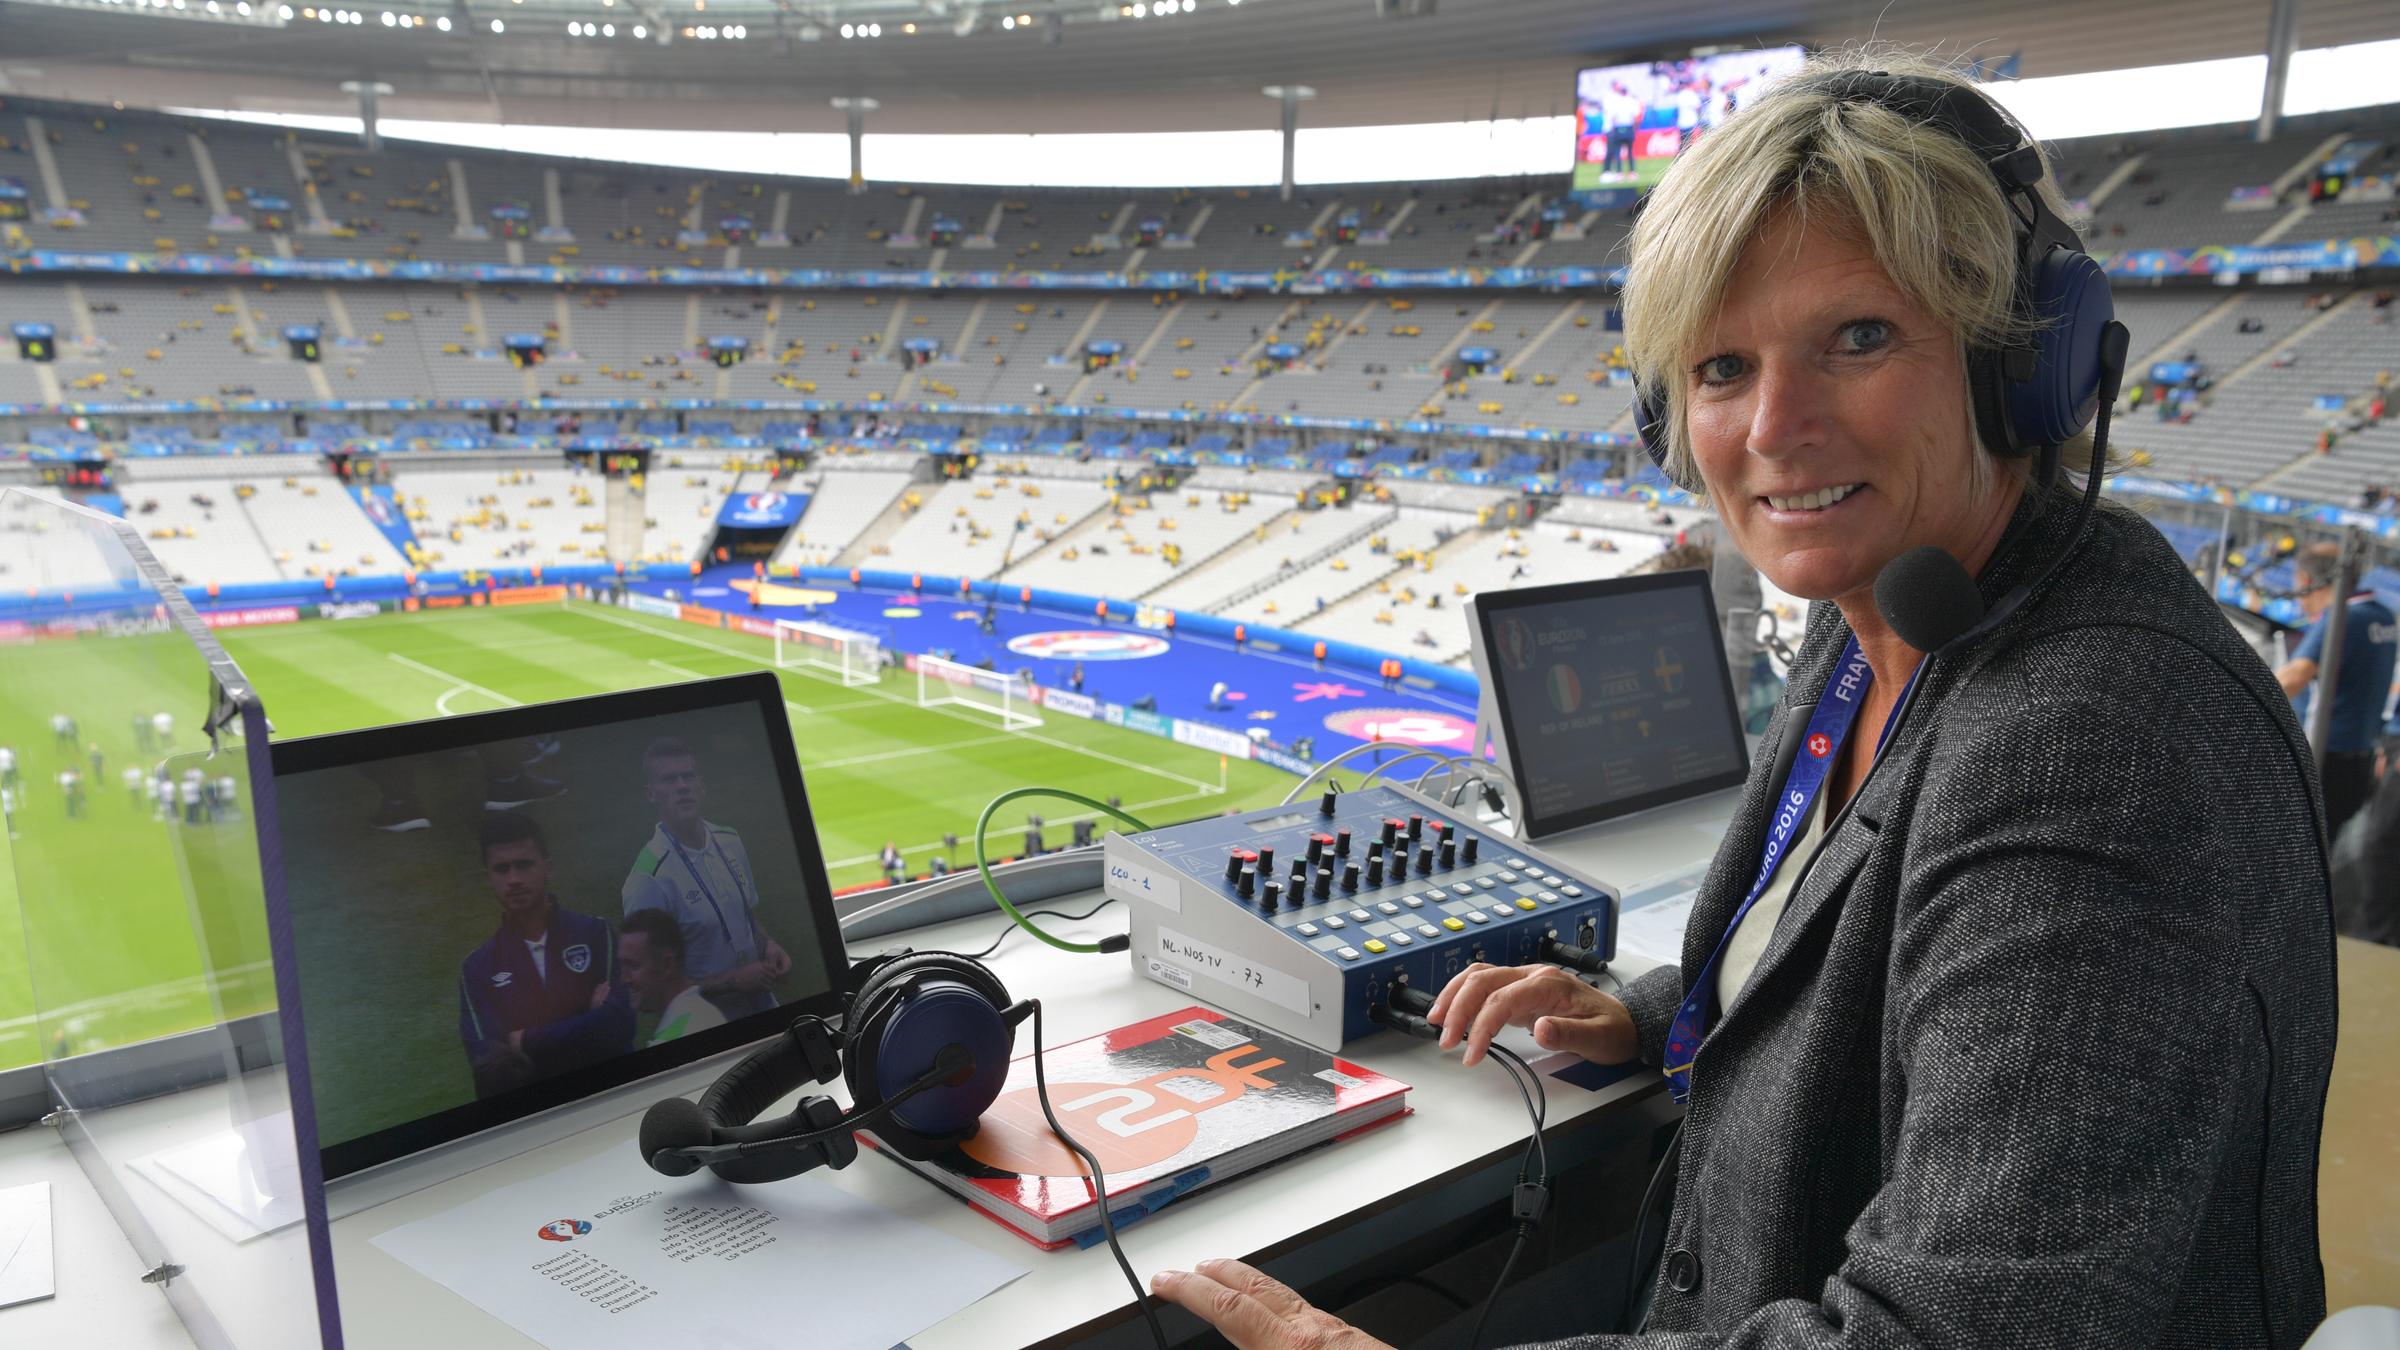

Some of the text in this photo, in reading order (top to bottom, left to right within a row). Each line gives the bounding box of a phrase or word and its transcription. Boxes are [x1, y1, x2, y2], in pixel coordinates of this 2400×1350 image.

[1753, 790, 1804, 893] EURO 2016
[1184, 946, 1204, 962] NOS
[1207, 955, 1222, 967] TV
[1244, 967, 1263, 988] 77
[660, 1233, 679, 1243] Info
[687, 1216, 718, 1232] (Match
[719, 1206, 741, 1218] Info)
[664, 1206, 698, 1223] Tactical
[682, 1211, 711, 1225] Match
[662, 1242, 682, 1251] Info
[689, 1207, 758, 1240] (Teams/Players)
[668, 1249, 688, 1259] Info
[695, 1231, 727, 1247] (Group
[726, 1210, 772, 1232] Standings)
[740, 1216, 780, 1237] matches)
[732, 1235, 760, 1249] Match
[532, 1252, 571, 1270] Channel
[541, 1257, 581, 1276] Channel
[551, 1262, 590, 1281] Channel
[560, 1267, 600, 1287] Channel
[570, 1272, 610, 1292] Channel
[580, 1278, 619, 1298] Channel
[590, 1284, 629, 1303] Channel
[600, 1289, 639, 1309] Channel
[610, 1294, 650, 1314] Channel
